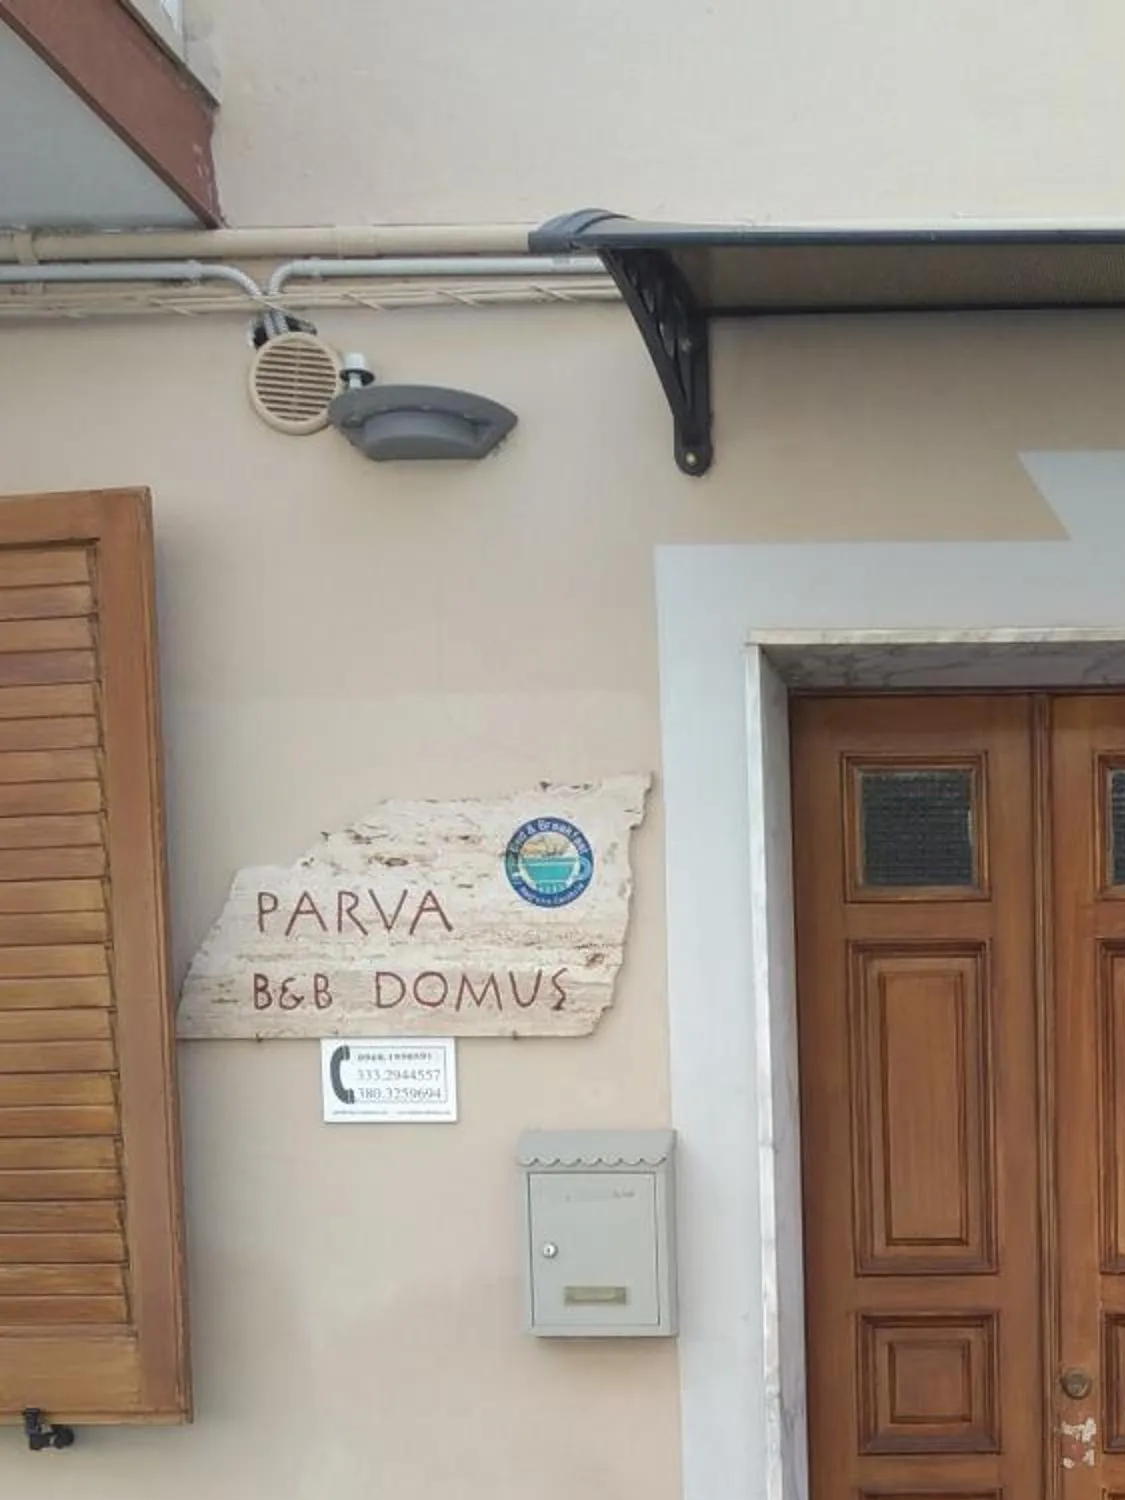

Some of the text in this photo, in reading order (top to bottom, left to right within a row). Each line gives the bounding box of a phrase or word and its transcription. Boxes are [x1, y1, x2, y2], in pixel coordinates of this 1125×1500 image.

[256, 888, 454, 936] PARVA
[253, 967, 570, 1012] B&B DOMUS
